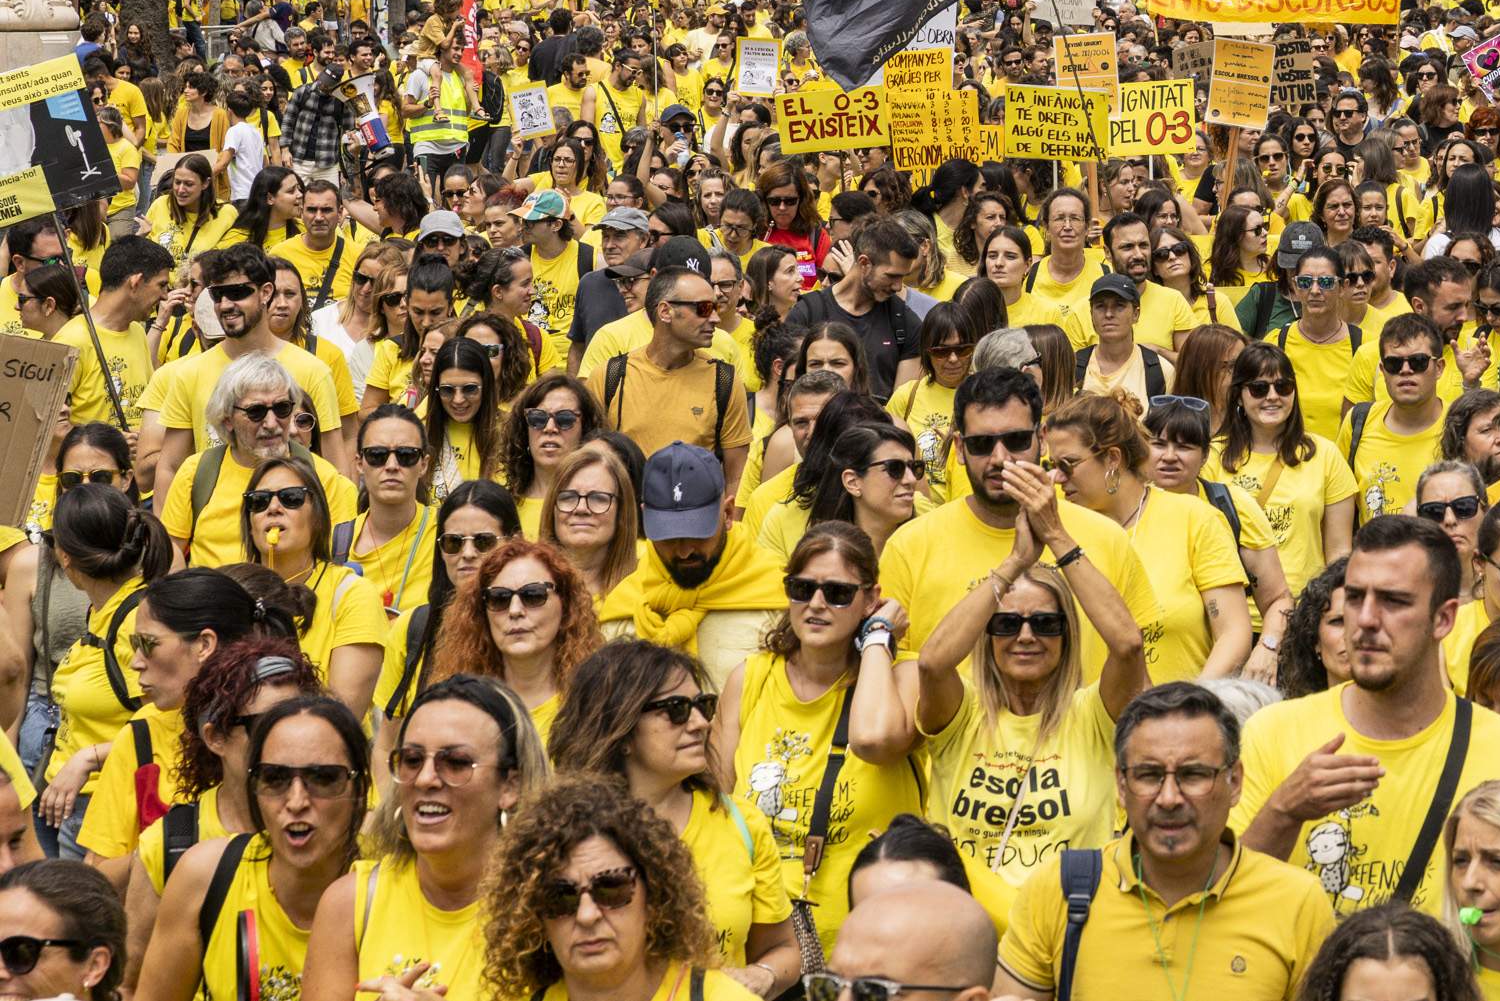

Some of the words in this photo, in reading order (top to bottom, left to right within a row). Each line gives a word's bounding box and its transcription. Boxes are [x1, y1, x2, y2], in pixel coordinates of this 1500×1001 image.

[887, 51, 945, 69] COMPANYES
[1274, 56, 1294, 71] VEU
[6, 70, 30, 81] sents
[51, 70, 73, 83] quan
[923, 71, 941, 82] PER
[1214, 69, 1236, 79] ESCOLA
[1236, 72, 1260, 82] BRESSOL
[2, 95, 22, 107] veus
[24, 90, 43, 102] això
[44, 88, 50, 96] a
[51, 78, 83, 94] classe?
[1010, 90, 1026, 103] LA
[1270, 83, 1316, 104] FUTUR
[783, 97, 813, 117] EL
[1016, 104, 1032, 121] TÉ
[1038, 111, 1078, 126] DRETS
[789, 110, 883, 143] EXISTEIX
[1012, 124, 1043, 137] ALGÚ
[1047, 128, 1071, 142] ELS
[1110, 119, 1142, 146] PEL
[895, 144, 943, 168] VERGONYA
[1016, 143, 1032, 153] DE
[0, 205, 22, 222] MEN
[3, 358, 55, 382] SIGUI
